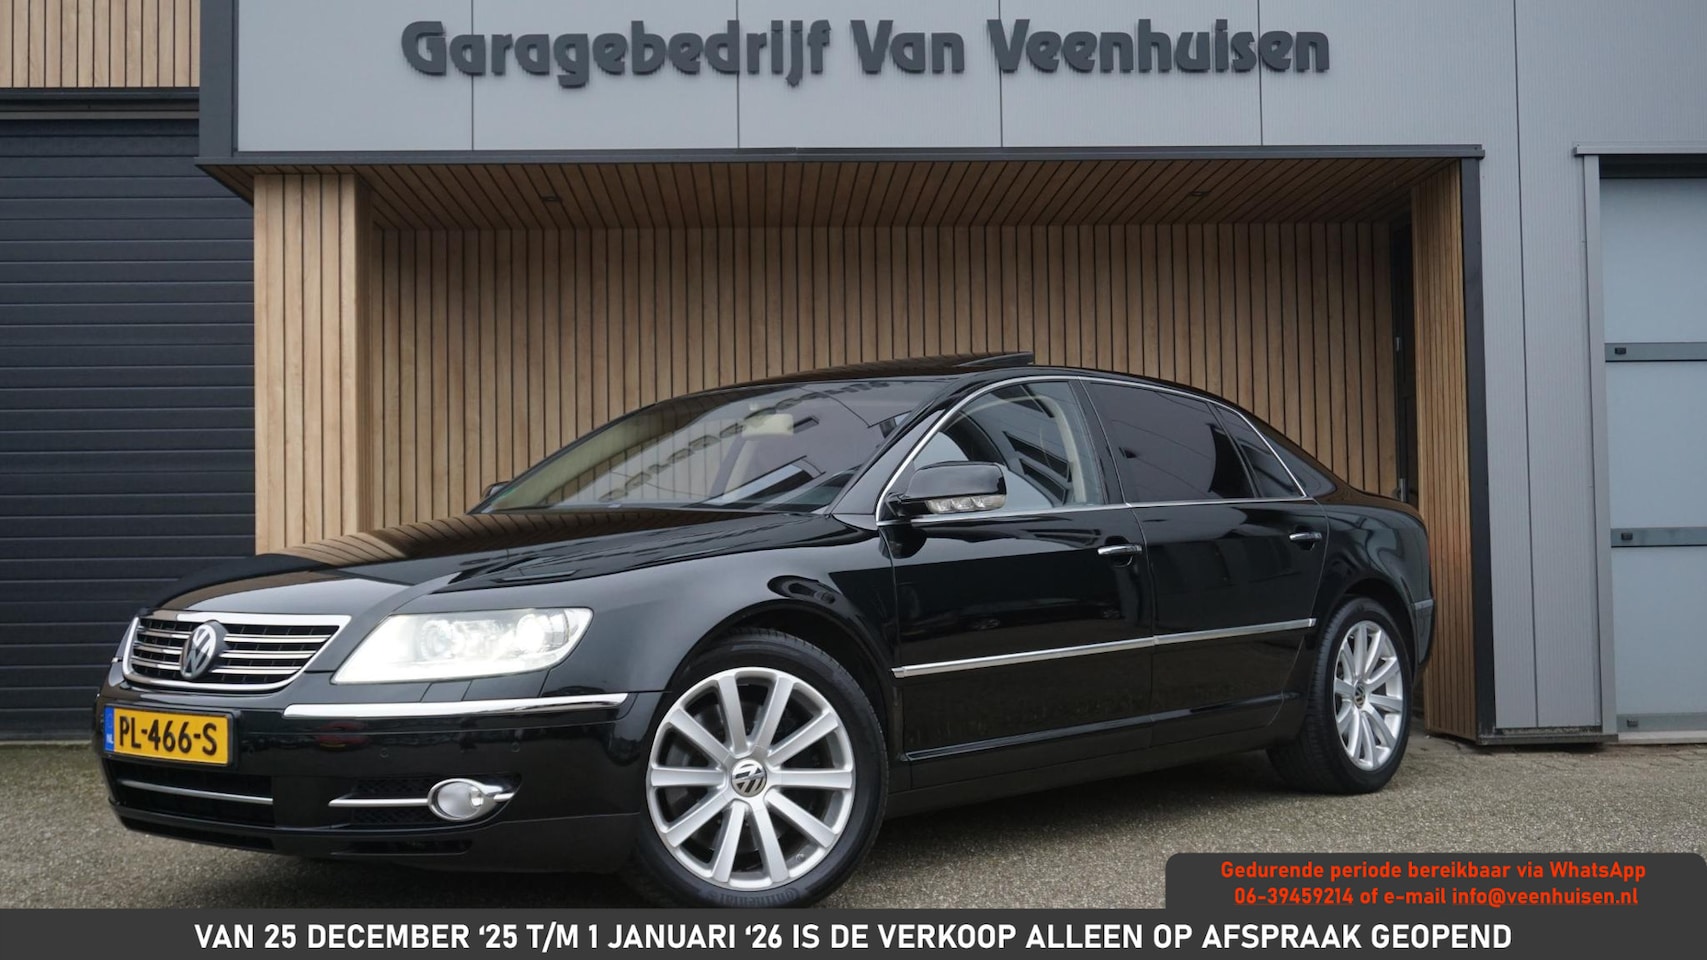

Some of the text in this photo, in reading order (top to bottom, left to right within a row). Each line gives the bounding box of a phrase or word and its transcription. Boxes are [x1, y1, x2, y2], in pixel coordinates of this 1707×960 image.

[402, 19, 1330, 87] Garagebedrijf Van Veenhuisen
[119, 716, 218, 757] PL-466-S
